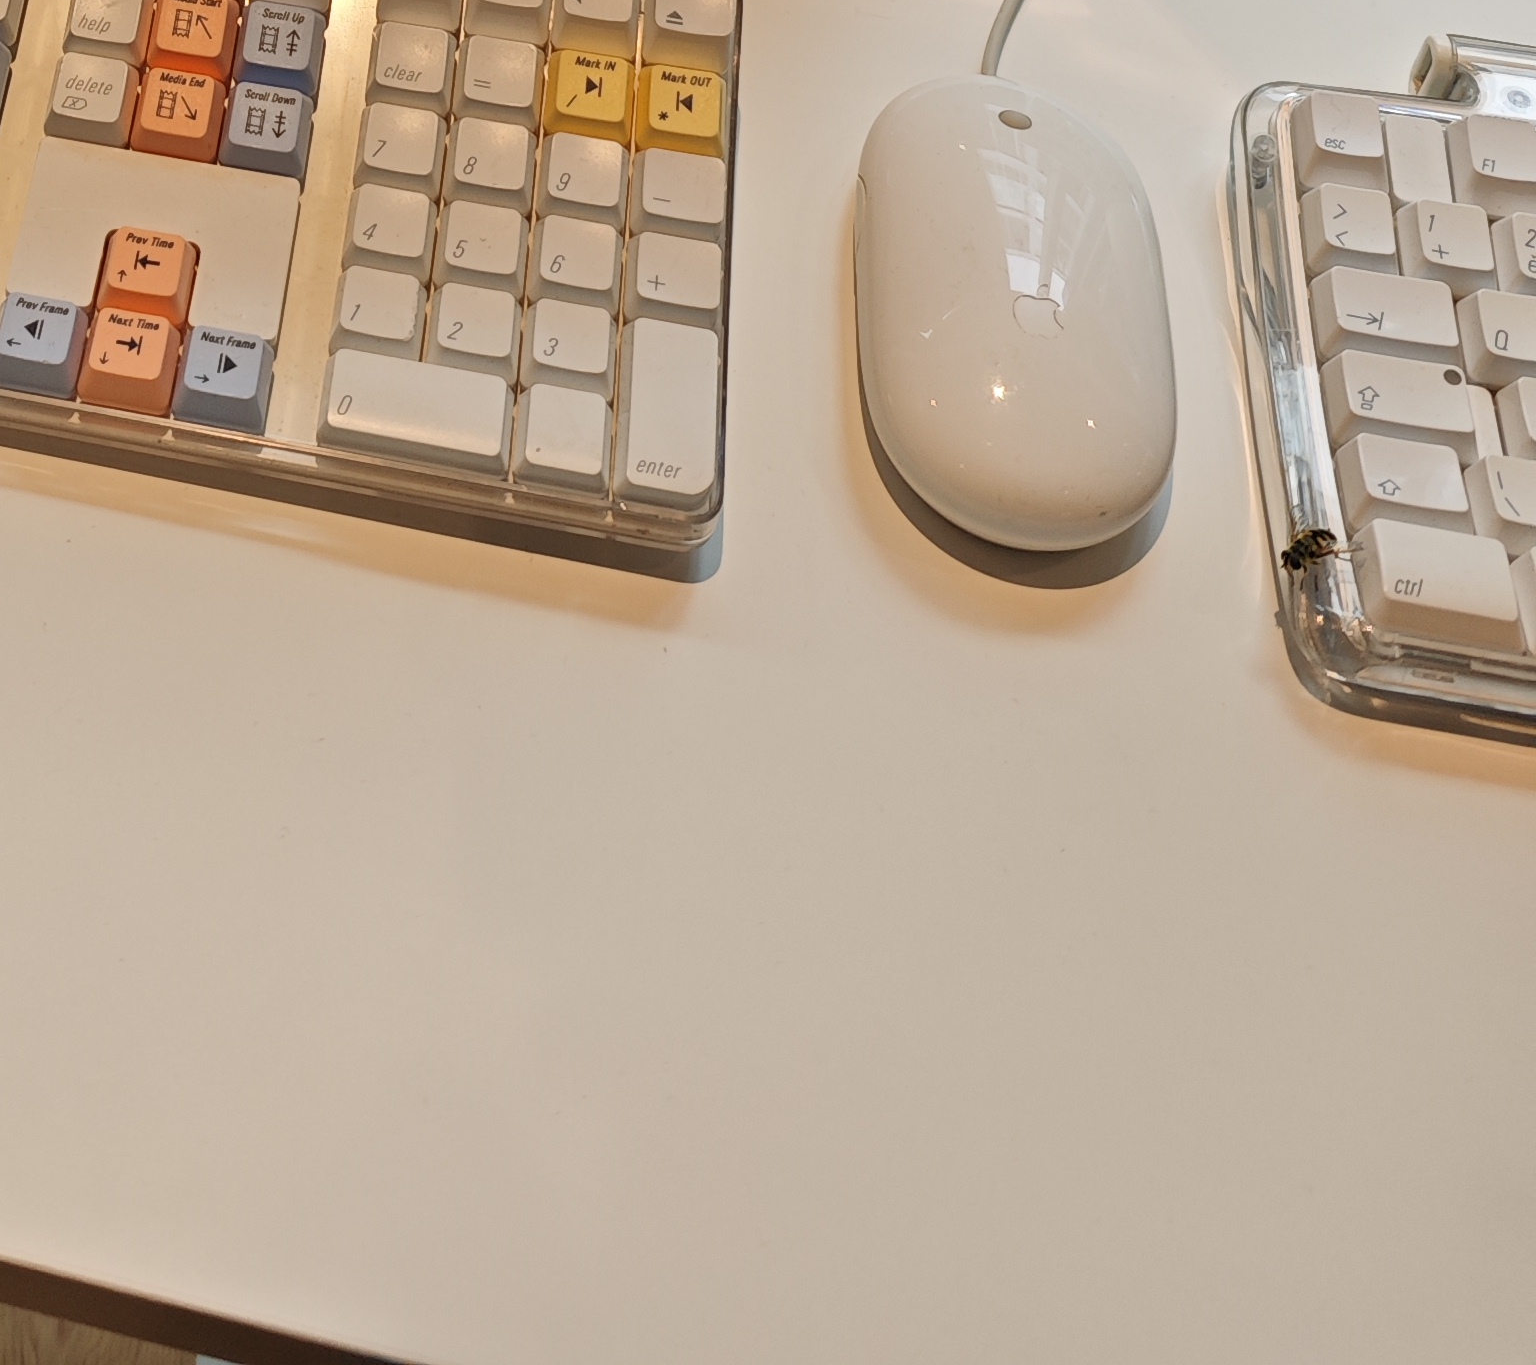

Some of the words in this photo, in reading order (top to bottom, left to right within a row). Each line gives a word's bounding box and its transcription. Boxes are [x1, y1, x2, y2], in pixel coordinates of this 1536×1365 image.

[77, 13, 111, 37] help
[383, 63, 422, 84] clear
[64, 74, 114, 97] delete
[635, 458, 682, 480] enter
